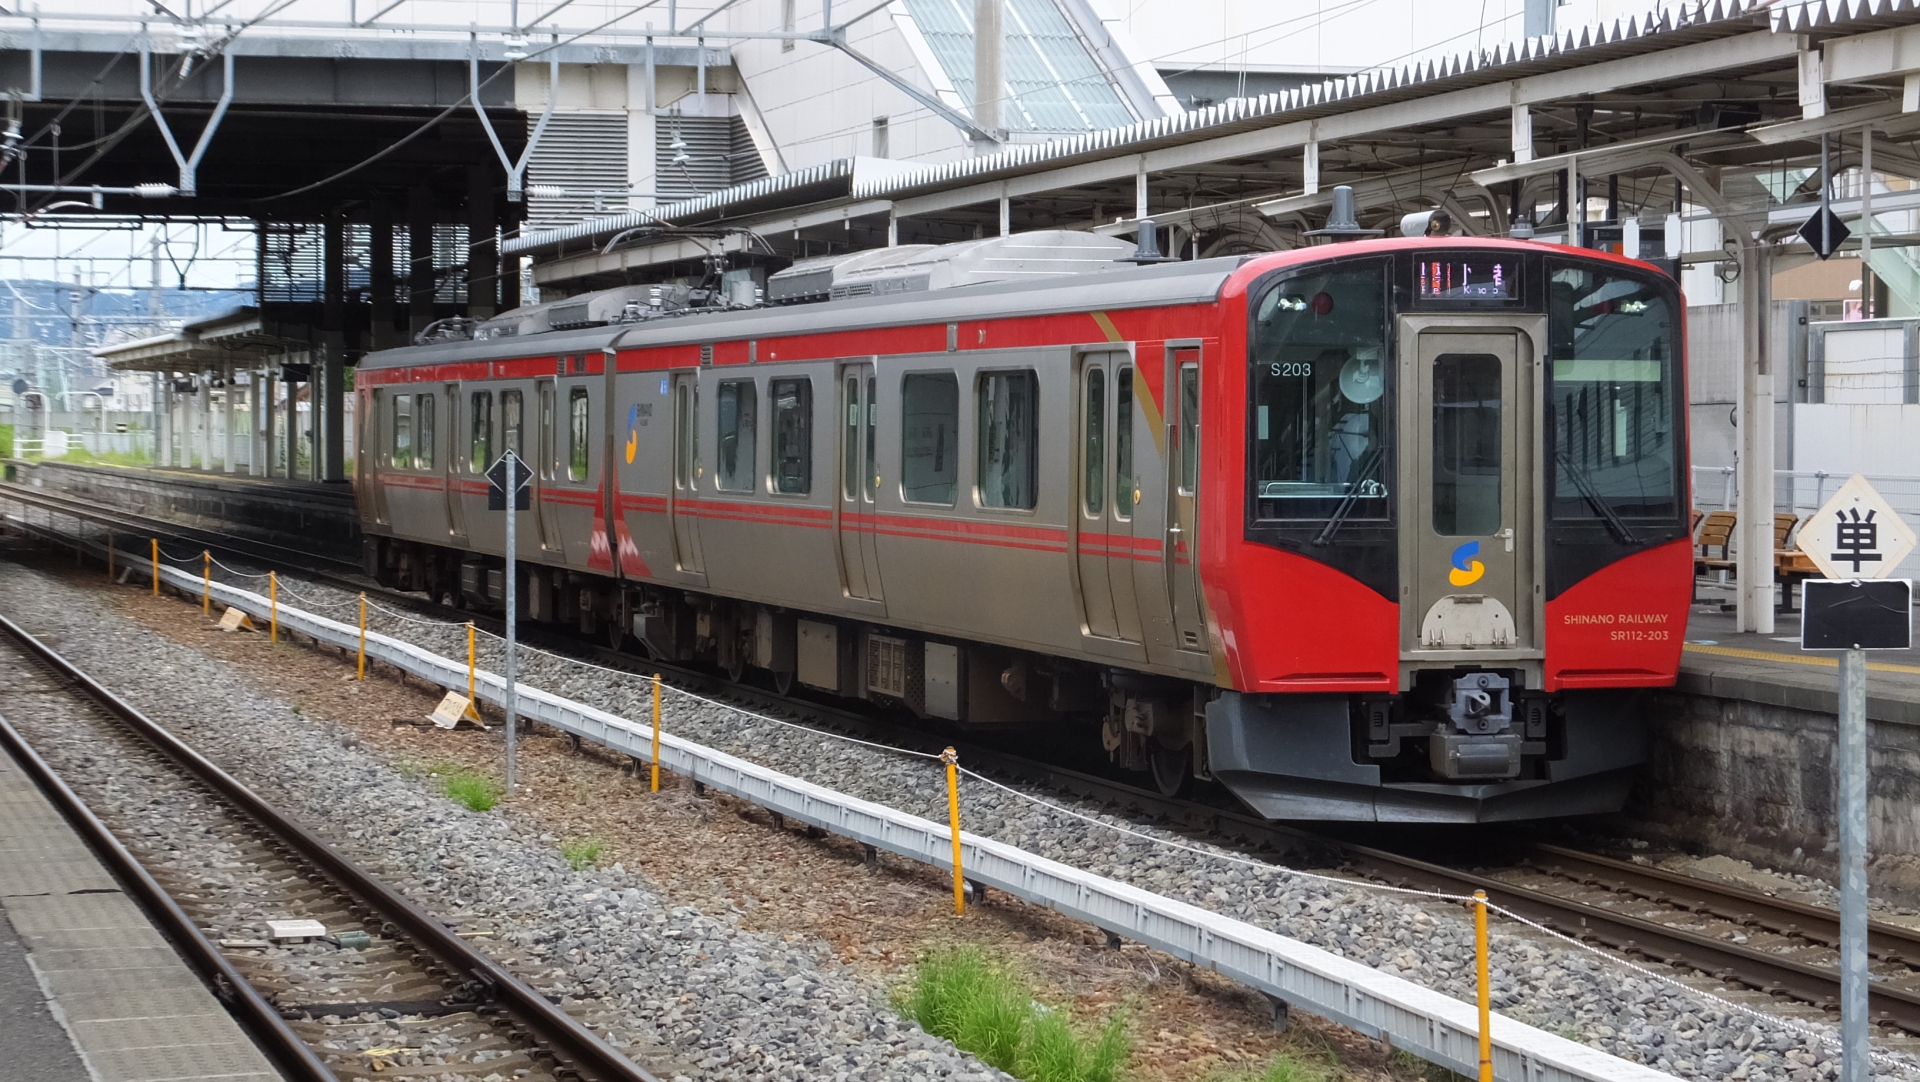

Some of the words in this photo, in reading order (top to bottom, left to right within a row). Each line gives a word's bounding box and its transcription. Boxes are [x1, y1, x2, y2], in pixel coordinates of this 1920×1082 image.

[1271, 362, 1311, 376] S203
[1830, 507, 1882, 572] 単
[1564, 614, 1615, 625] SHINANO
[1618, 614, 1668, 623] RAILWAY
[1610, 631, 1669, 641] SR112-203
